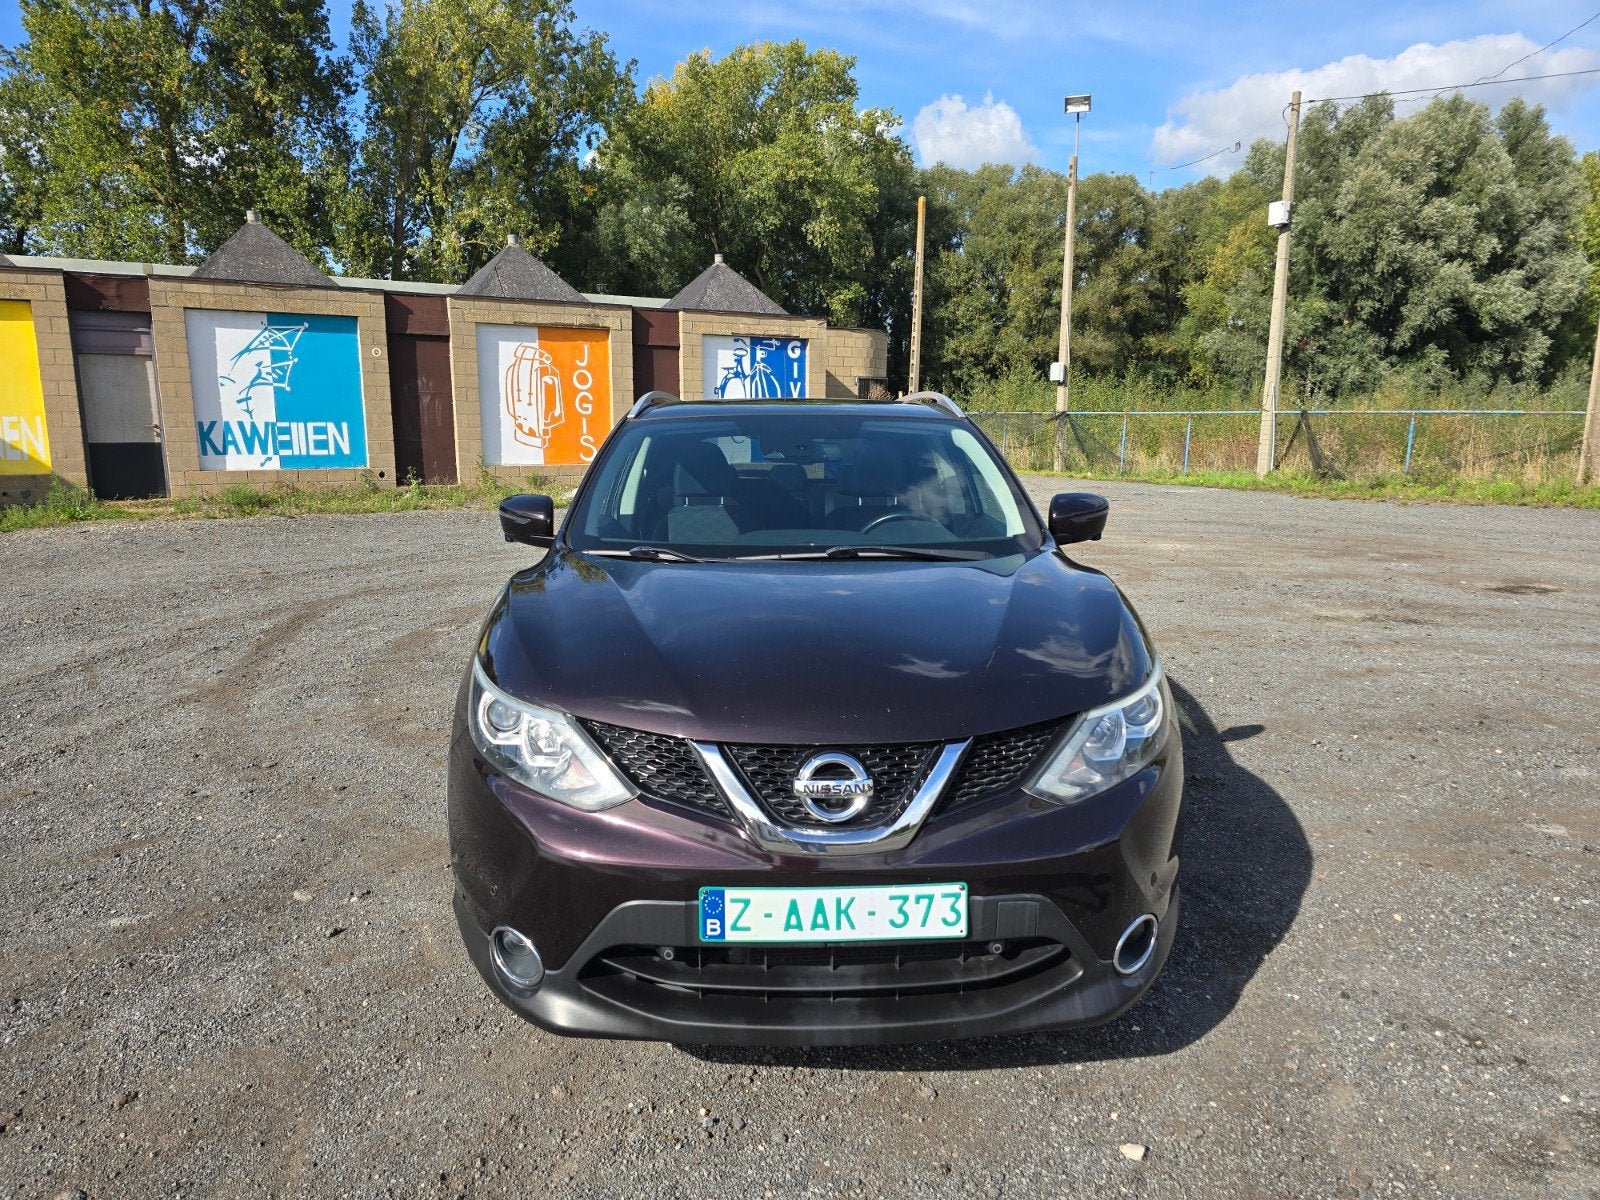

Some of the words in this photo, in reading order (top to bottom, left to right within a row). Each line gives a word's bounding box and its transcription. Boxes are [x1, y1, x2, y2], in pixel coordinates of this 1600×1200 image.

[573, 344, 598, 462] JOGIS
[803, 784, 865, 794] NISSAN
[706, 919, 721, 936] B
